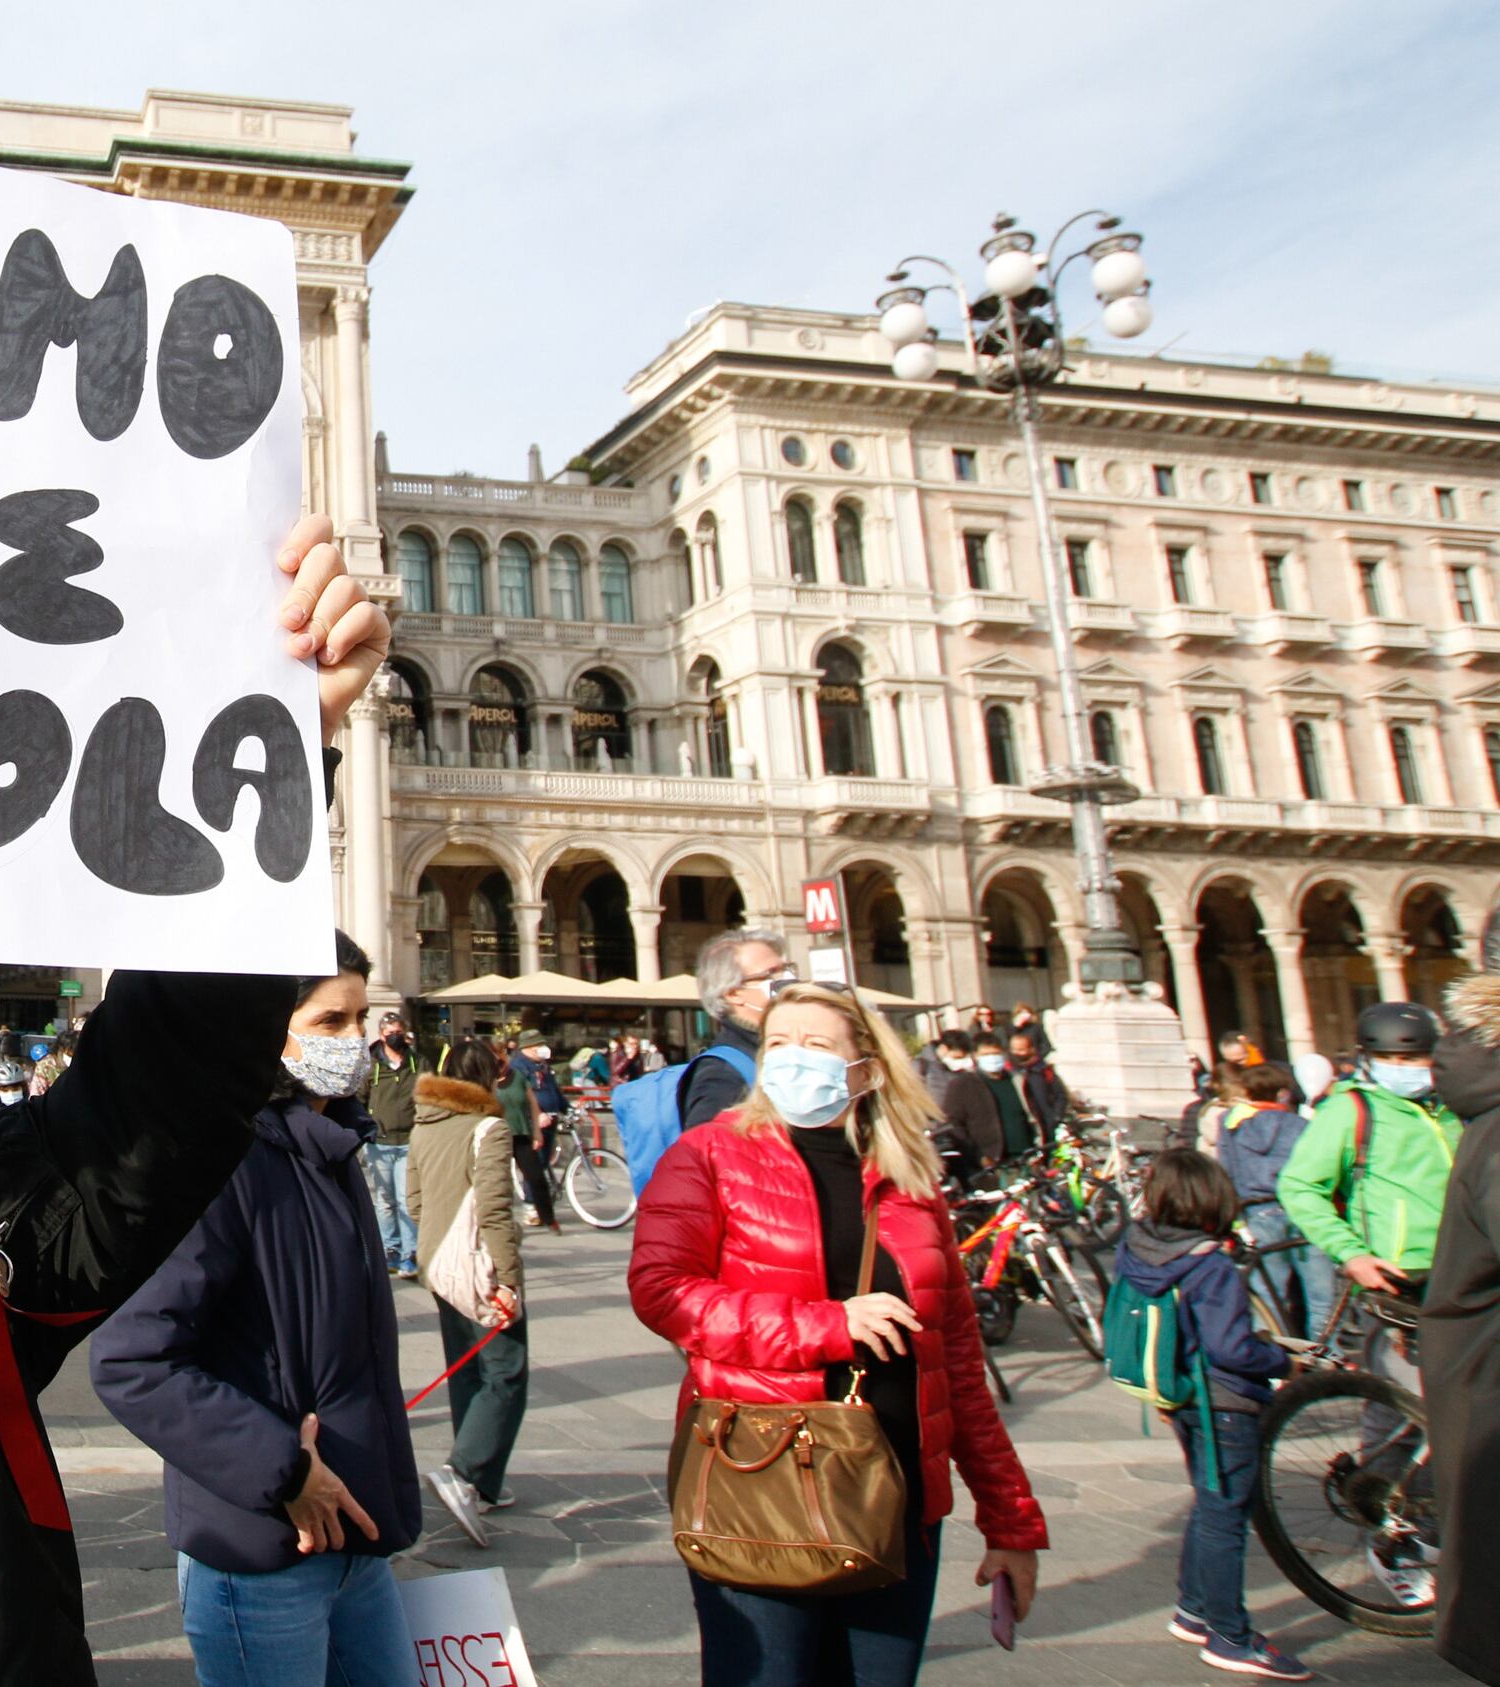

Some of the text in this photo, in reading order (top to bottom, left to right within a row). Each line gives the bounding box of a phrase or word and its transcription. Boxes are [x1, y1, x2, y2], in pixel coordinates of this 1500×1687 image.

[468, 704, 517, 724] APEROL
[806, 887, 837, 923] M
[413, 1631, 519, 1687] ESSE
